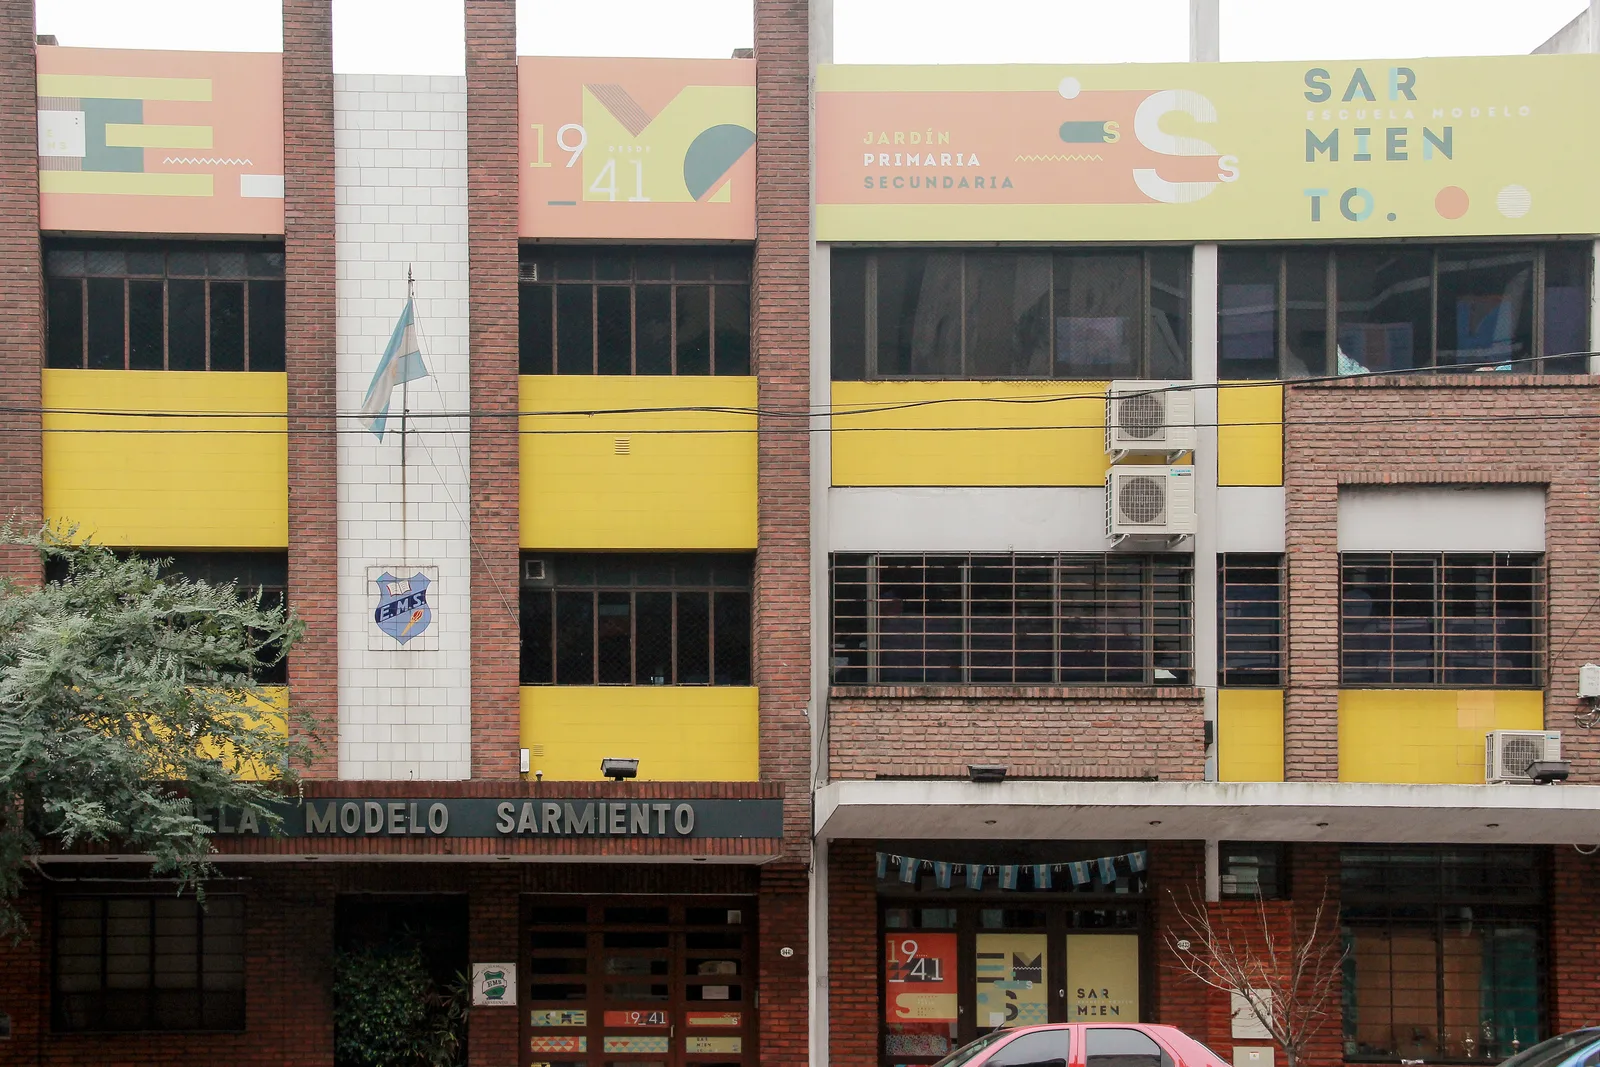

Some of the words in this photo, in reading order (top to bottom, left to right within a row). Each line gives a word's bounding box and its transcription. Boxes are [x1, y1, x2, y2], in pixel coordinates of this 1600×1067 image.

[1303, 67, 1418, 103] SAR
[1306, 108, 1415, 121] ESCUELA
[1432, 105, 1532, 119] MODELO
[529, 123, 588, 168] 19
[863, 128, 951, 145] JARDÍN
[1305, 126, 1453, 162] MIEN
[608, 145, 652, 153] DESDE
[863, 153, 981, 167] PRIMARIA
[588, 158, 651, 202] 41
[863, 176, 1014, 189] SECUNDARIA
[1303, 187, 1397, 222] TO.
[305, 802, 449, 835] MODELO
[495, 802, 695, 835] SARMIENTO
[888, 940, 919, 963] 19
[910, 958, 944, 981] 41
[1077, 988, 1109, 999] SAR
[1077, 1005, 1120, 1016] MIEN
